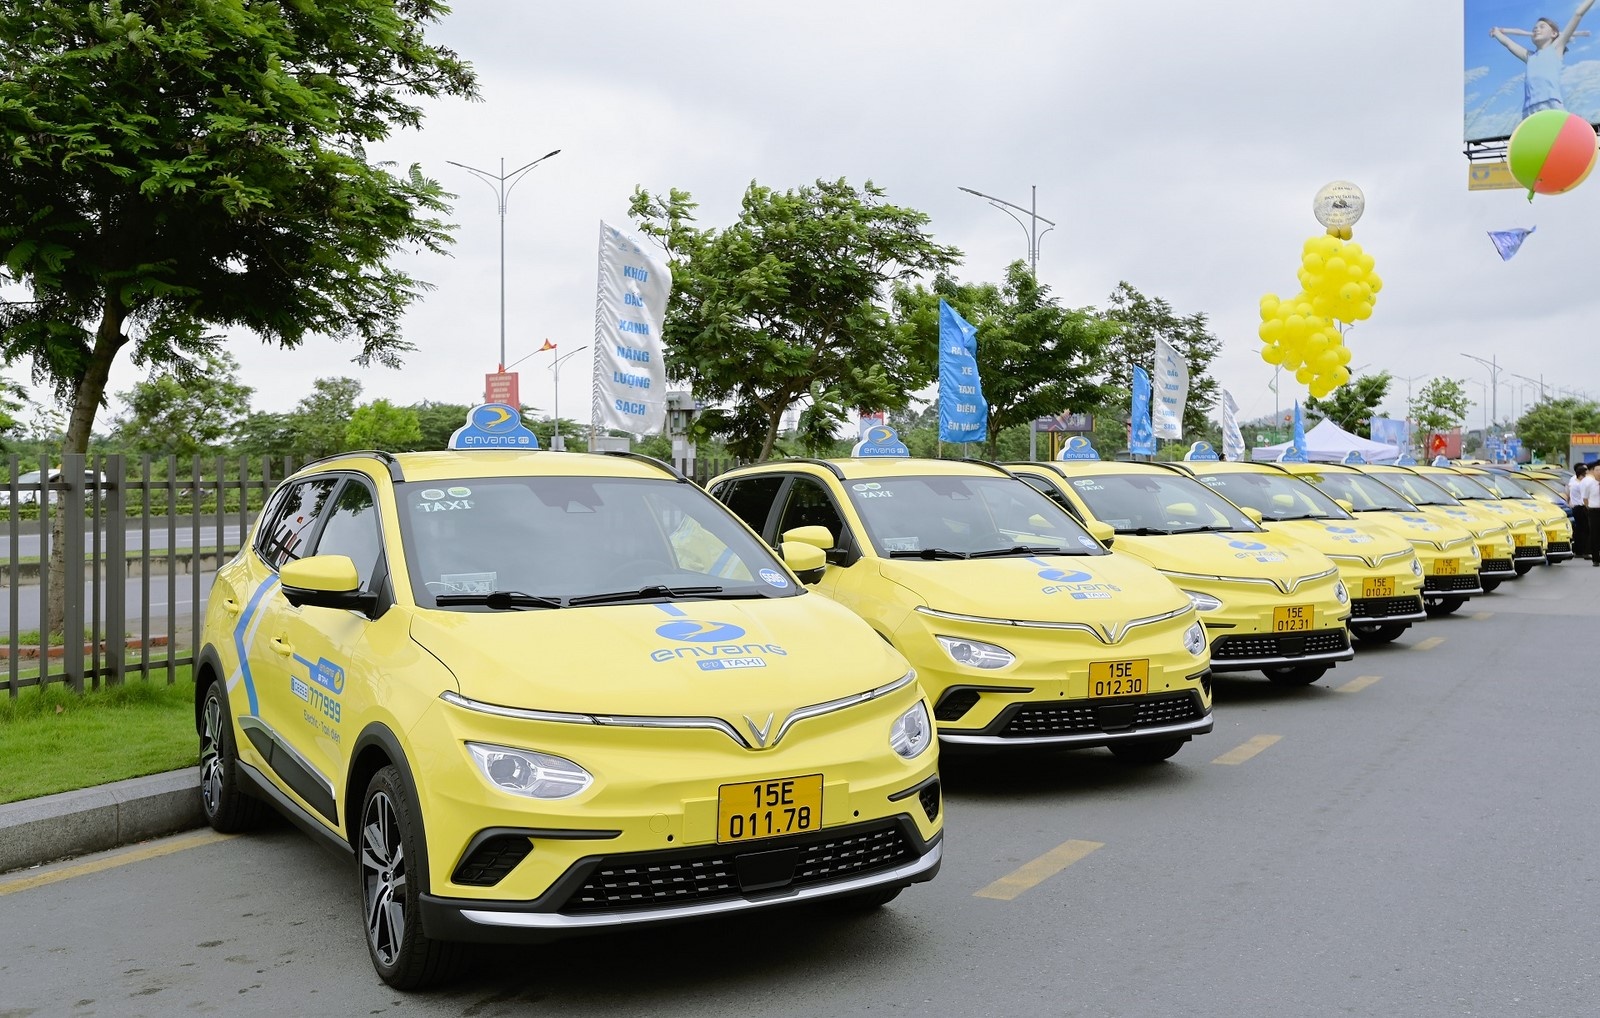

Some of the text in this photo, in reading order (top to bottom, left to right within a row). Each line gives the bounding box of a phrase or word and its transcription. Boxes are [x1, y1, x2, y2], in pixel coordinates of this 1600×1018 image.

[623, 265, 648, 283] KHỞI
[618, 320, 650, 336] XANH
[616, 345, 650, 363] NĂNG
[951, 346, 962, 355] RA
[961, 366, 972, 376] XE
[613, 371, 651, 389] LƯỢNG
[959, 385, 975, 394] TAXI
[615, 399, 646, 415] SẠCH
[860, 490, 893, 498] TAXI
[419, 500, 472, 513] TAXI
[1374, 578, 1387, 587] 15E
[1287, 607, 1303, 619] 15E
[1278, 619, 1309, 631] 012.31
[723, 658, 762, 667] TAXI
[1109, 662, 1133, 678] 15E
[1095, 678, 1142, 696] 012.30
[309, 686, 341, 724] 777999
[753, 781, 794, 808] 15E
[729, 806, 811, 838] 011.78
